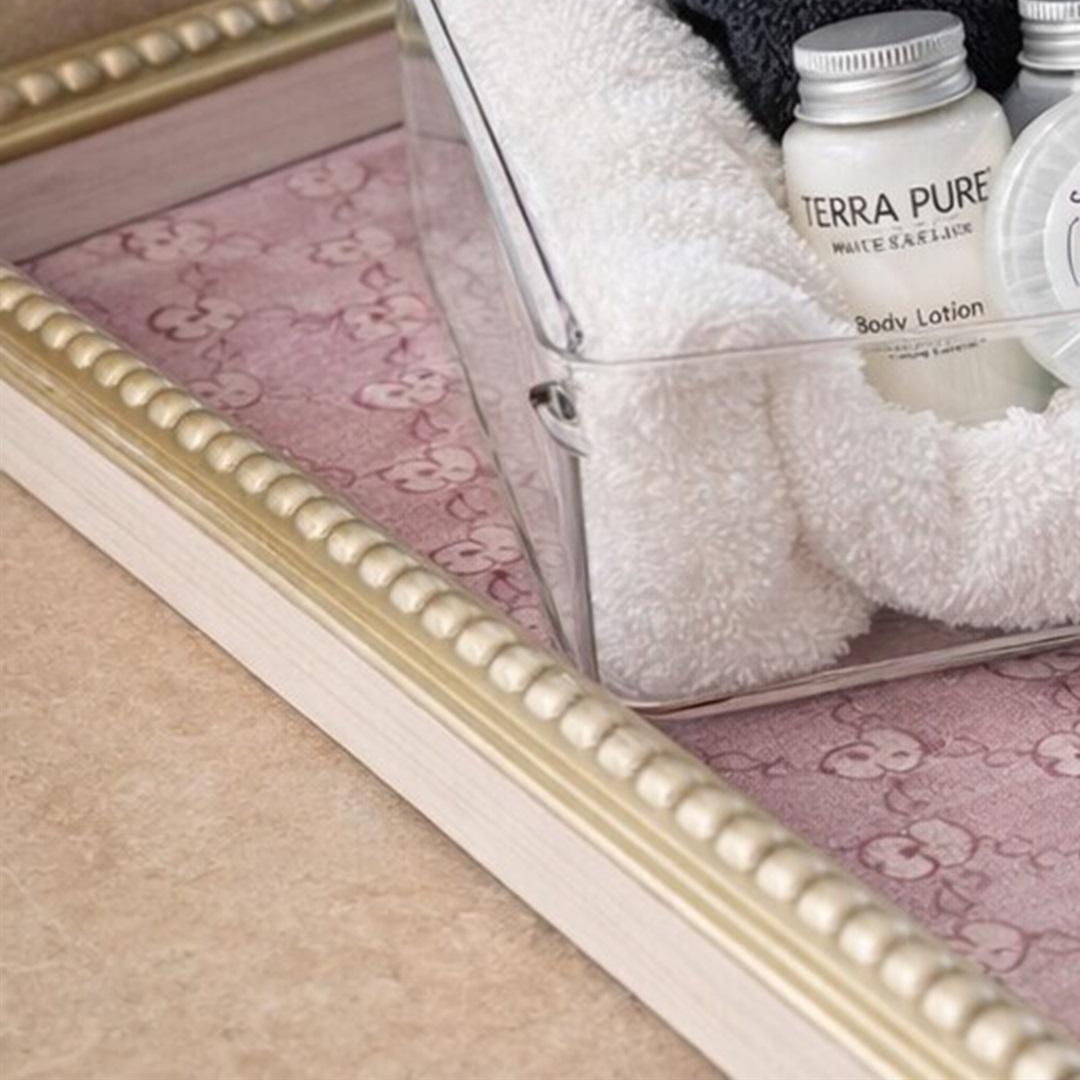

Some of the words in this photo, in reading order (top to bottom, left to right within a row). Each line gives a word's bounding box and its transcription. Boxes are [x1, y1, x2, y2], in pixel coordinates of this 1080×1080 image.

[802, 192, 899, 228] TERRA
[909, 169, 990, 219] PURE
[916, 300, 985, 327] Lotion
